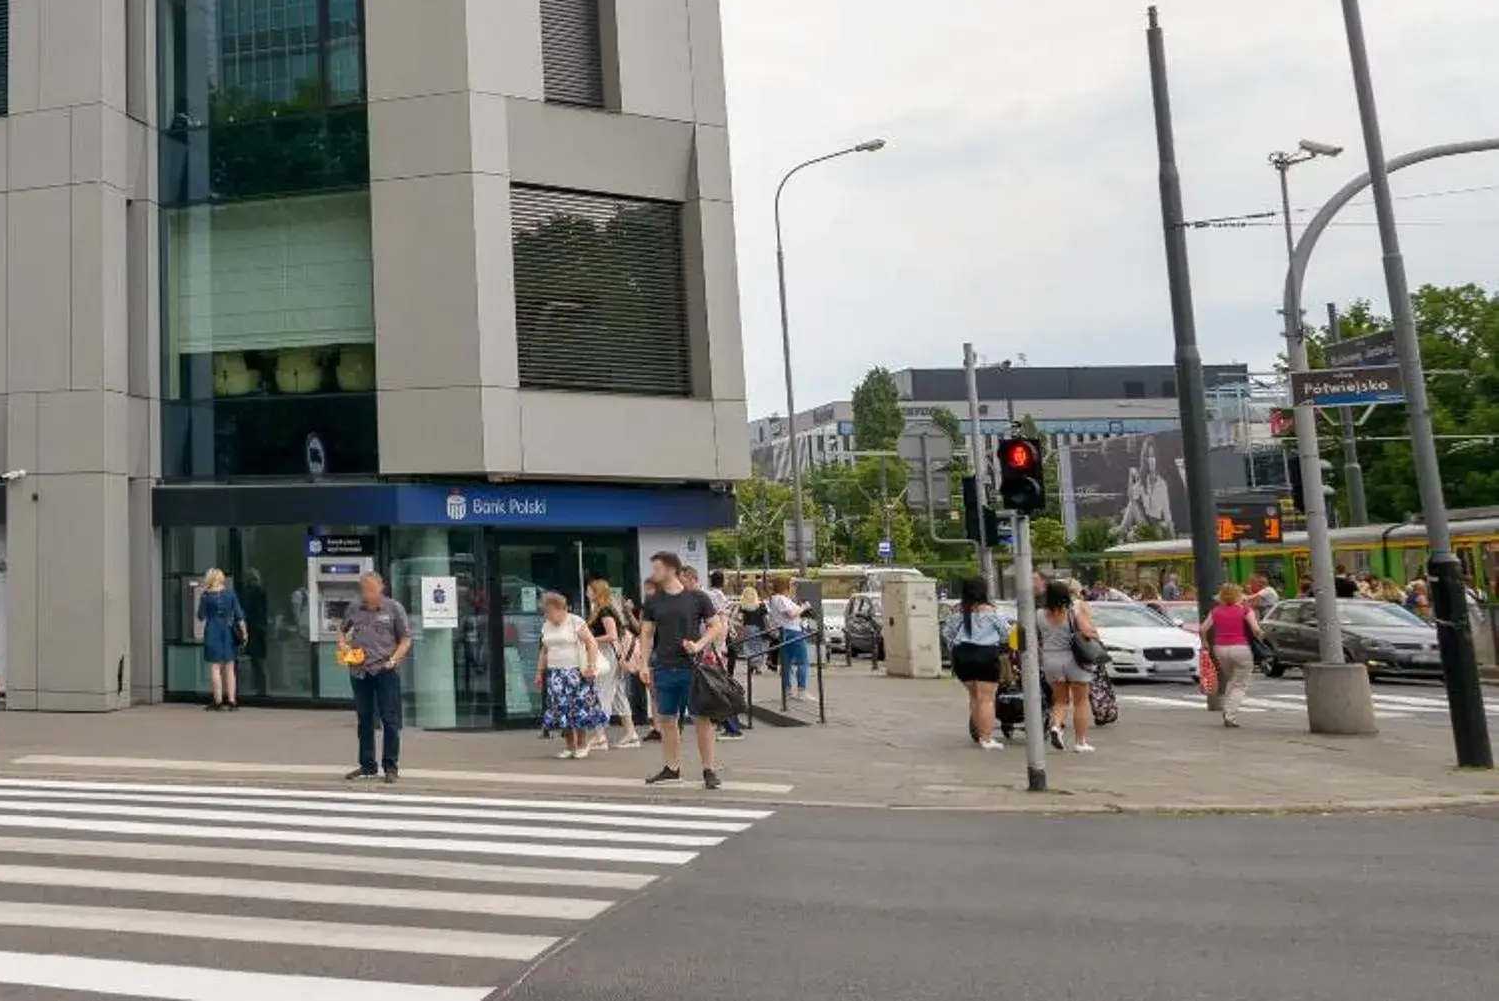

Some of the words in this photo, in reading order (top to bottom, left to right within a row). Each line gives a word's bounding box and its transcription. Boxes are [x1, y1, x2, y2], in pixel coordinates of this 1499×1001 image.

[1304, 379, 1389, 396] Półwiejska
[472, 498, 506, 514] Bank
[509, 498, 546, 514] Polski
